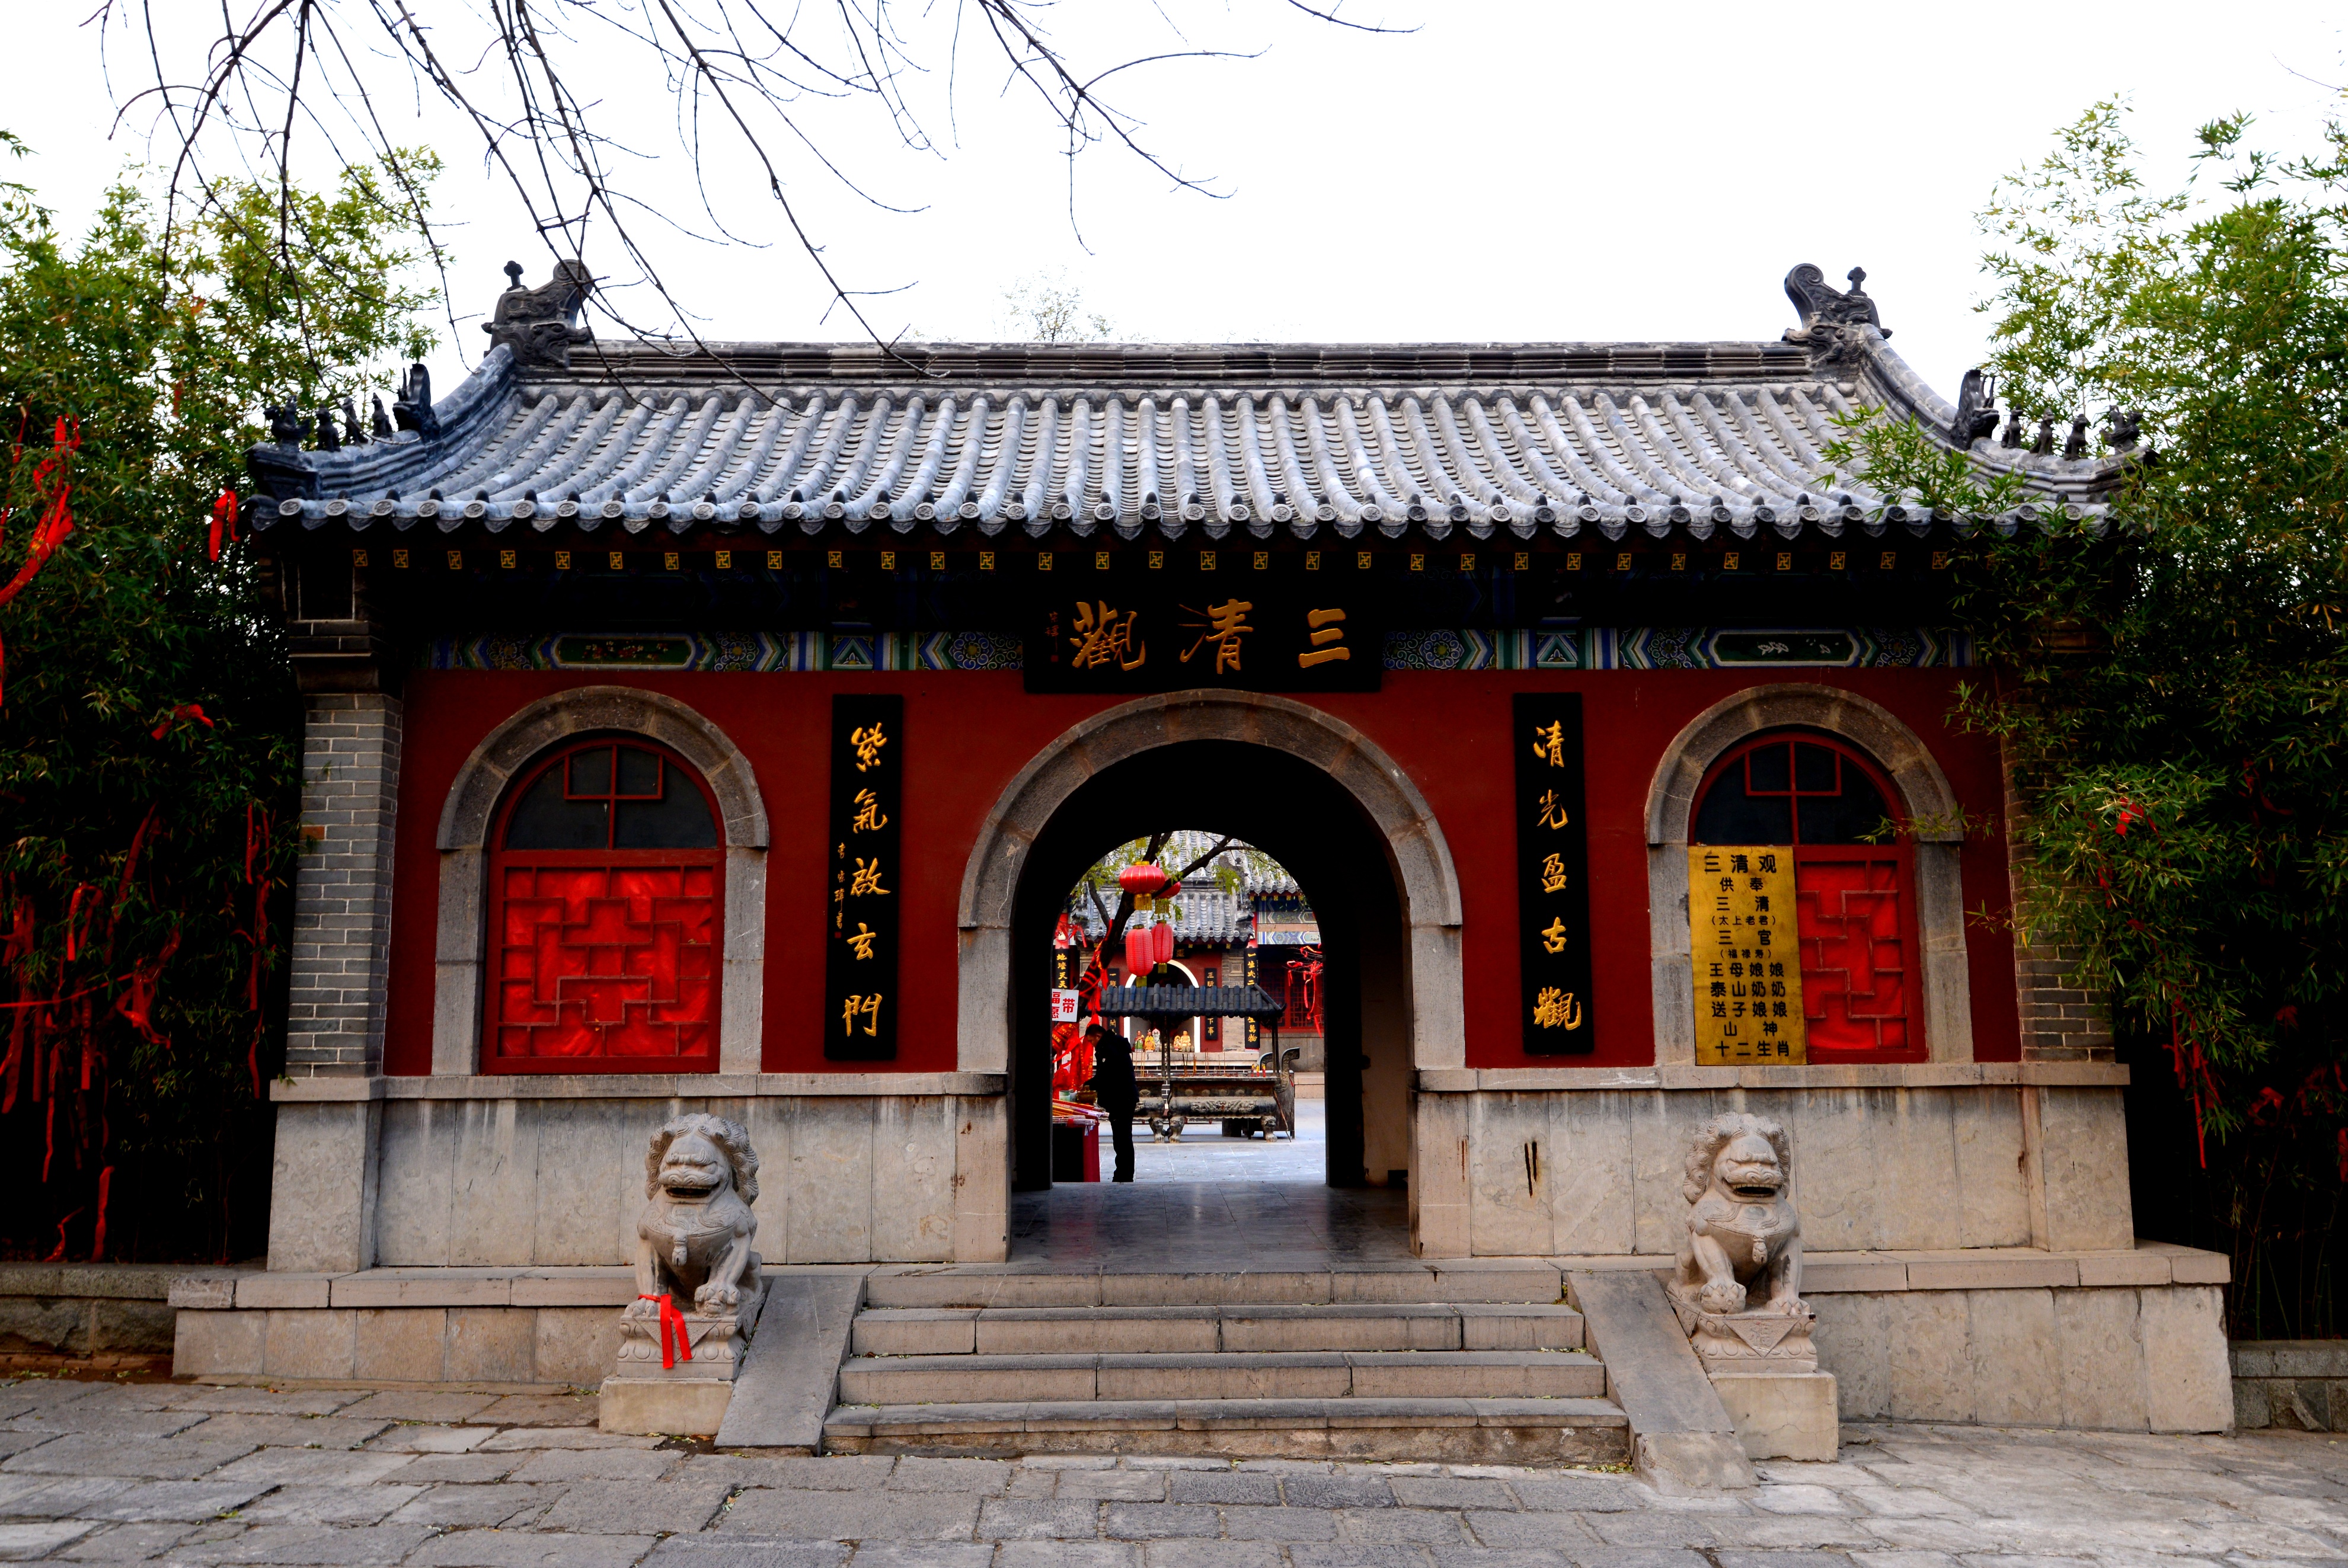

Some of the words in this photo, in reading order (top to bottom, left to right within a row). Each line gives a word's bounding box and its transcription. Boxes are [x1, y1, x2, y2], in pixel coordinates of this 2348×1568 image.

[1069, 599, 1350, 674] 三清觀
[1704, 854, 1777, 873] 三清观
[1534, 720, 1582, 1031] 清光盈古觀
[1720, 877, 1764, 892] 供奉
[1717, 895, 1769, 911] 三清
[1718, 929, 1772, 945] 三官
[1709, 962, 1784, 977] 王母娘娘
[1710, 981, 1785, 997] 泰山奶奶
[1062, 998, 1075, 1013] 带
[1711, 1001, 1788, 1017] 送子娘娘
[1724, 1021, 1778, 1036] 山神
[1715, 1041, 1790, 1057] 十二生肖
